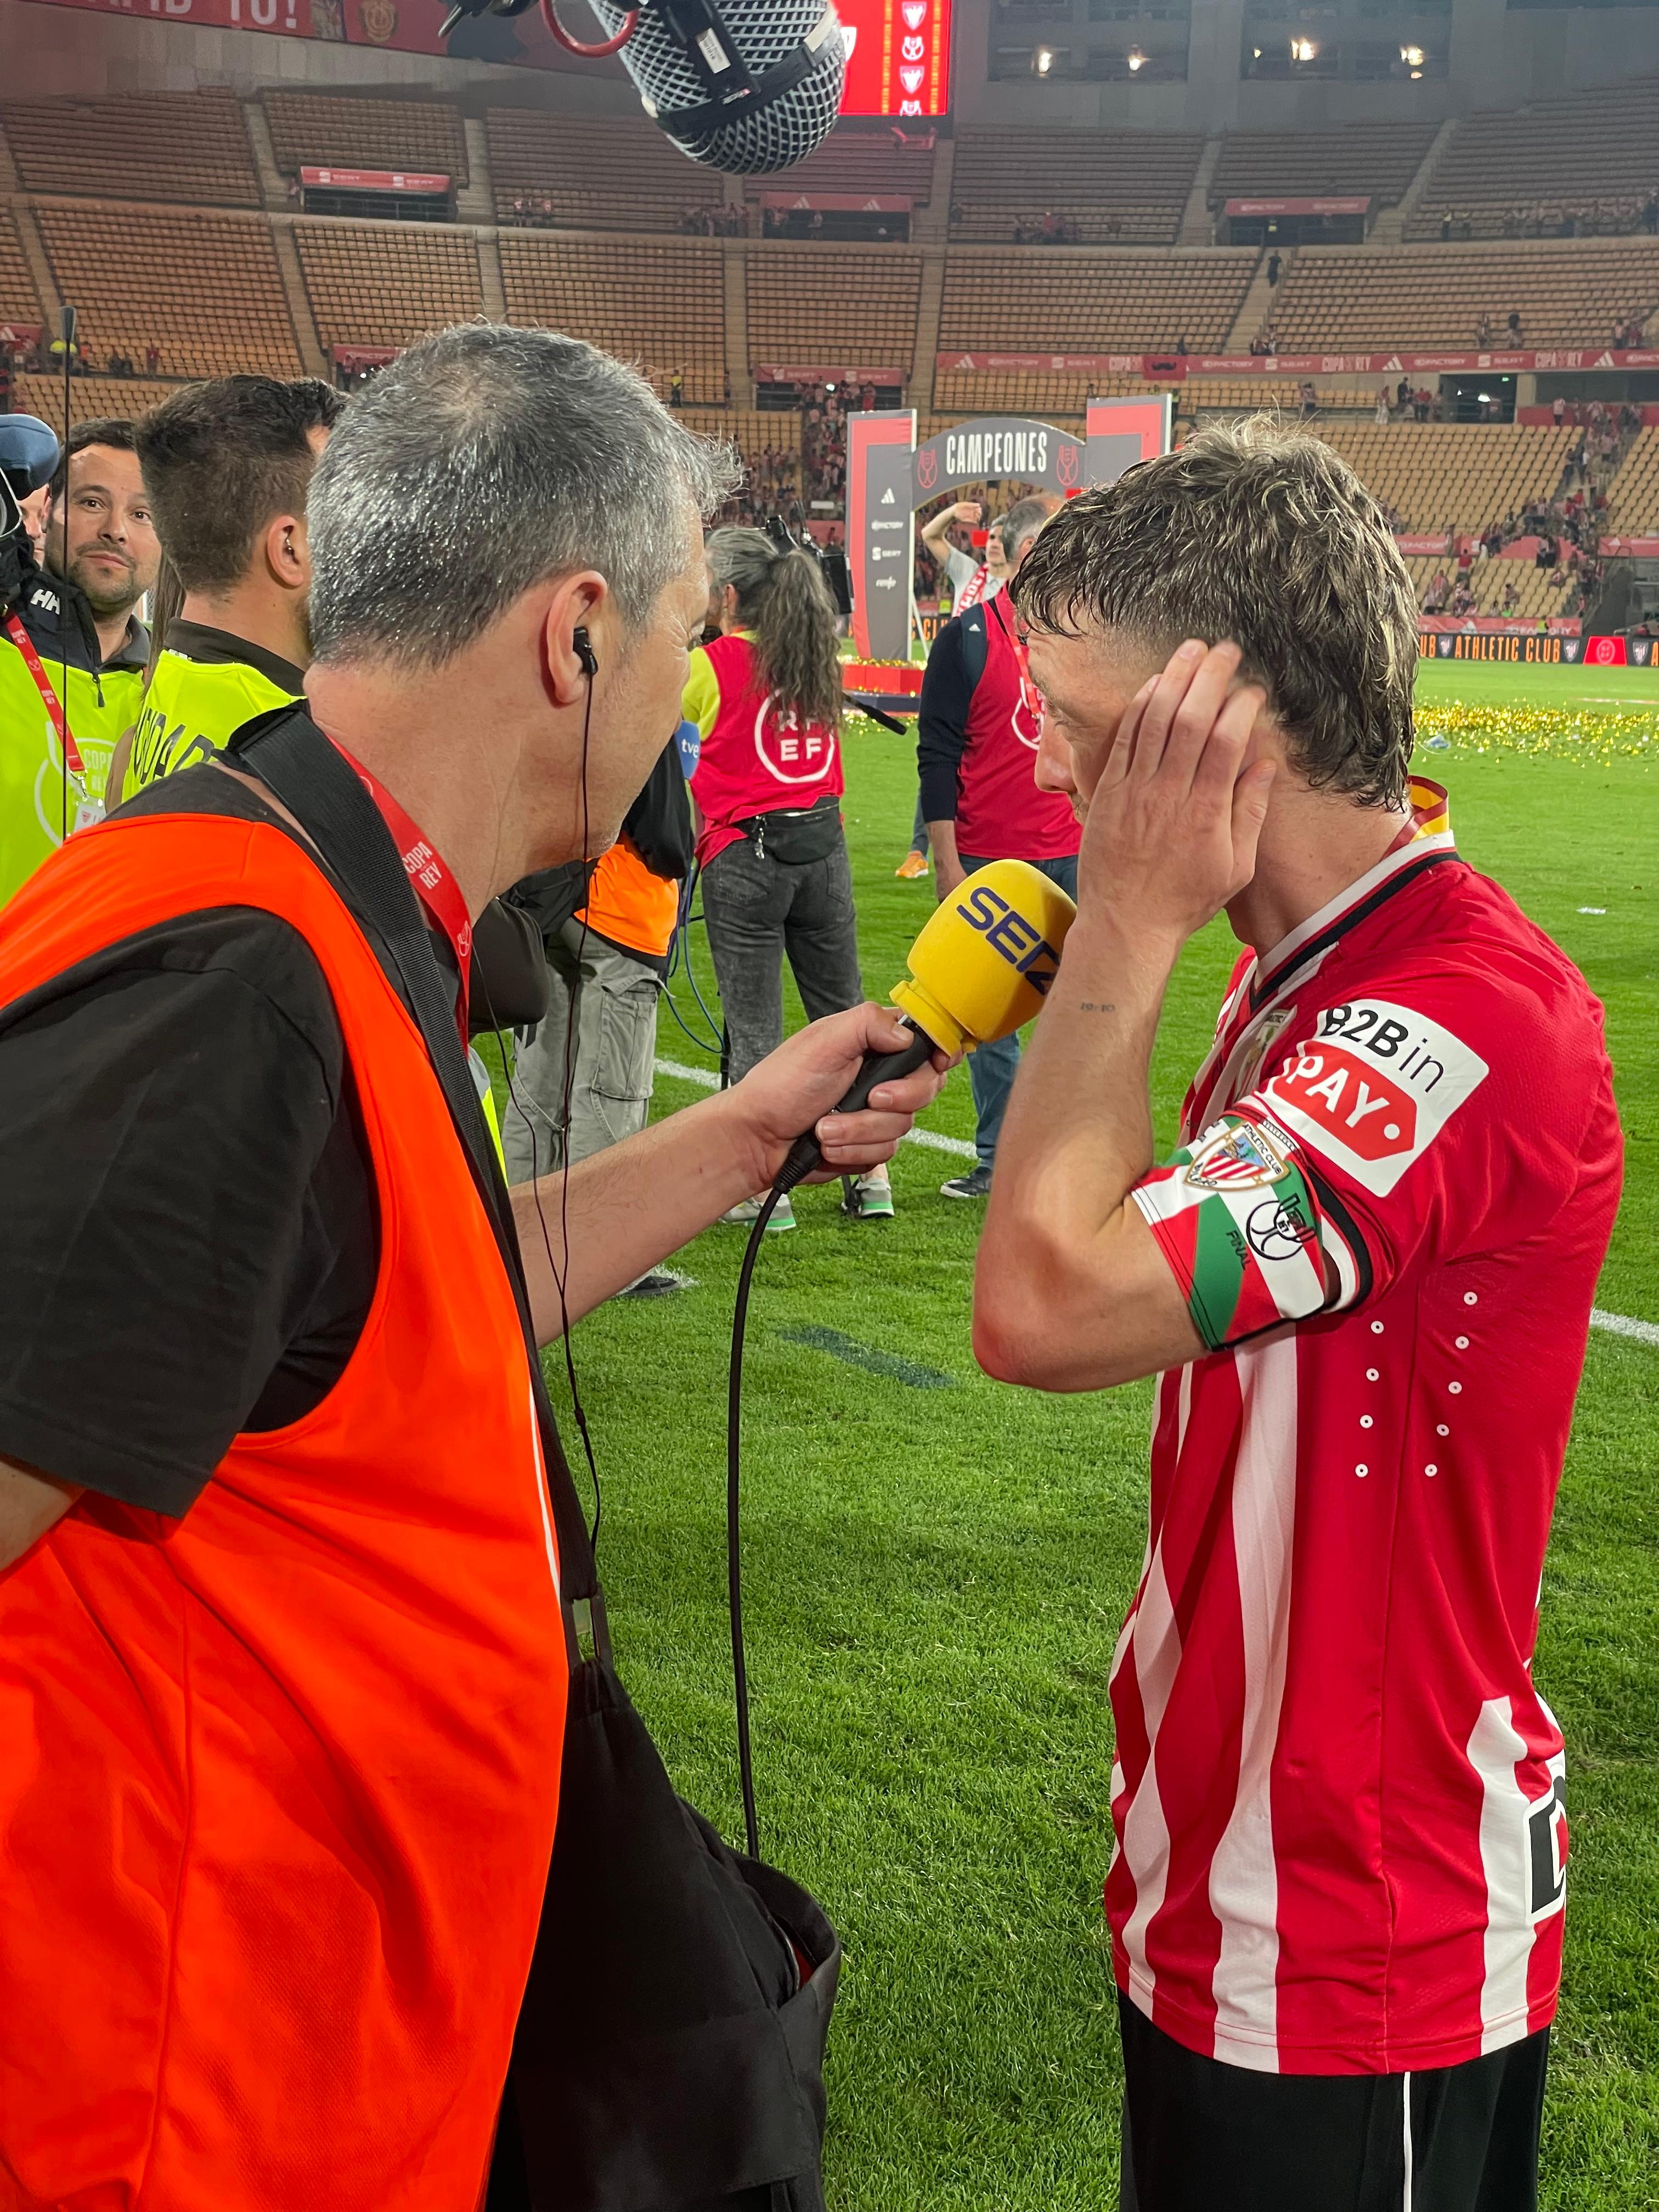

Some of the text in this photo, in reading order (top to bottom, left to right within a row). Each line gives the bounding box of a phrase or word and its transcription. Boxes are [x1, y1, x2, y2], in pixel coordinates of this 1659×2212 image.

[946, 431, 1047, 475] CAMPEONES
[1455, 635, 1560, 663] ATHLETIC CLUB
[681, 738, 699, 759] tve
[402, 841, 433, 874] COPA
[419, 861, 442, 889] REY
[1286, 1056, 1390, 1128] PAY
[1265, 1154, 1282, 1175] CLUB
[1226, 1229, 1251, 1271] FINAL
